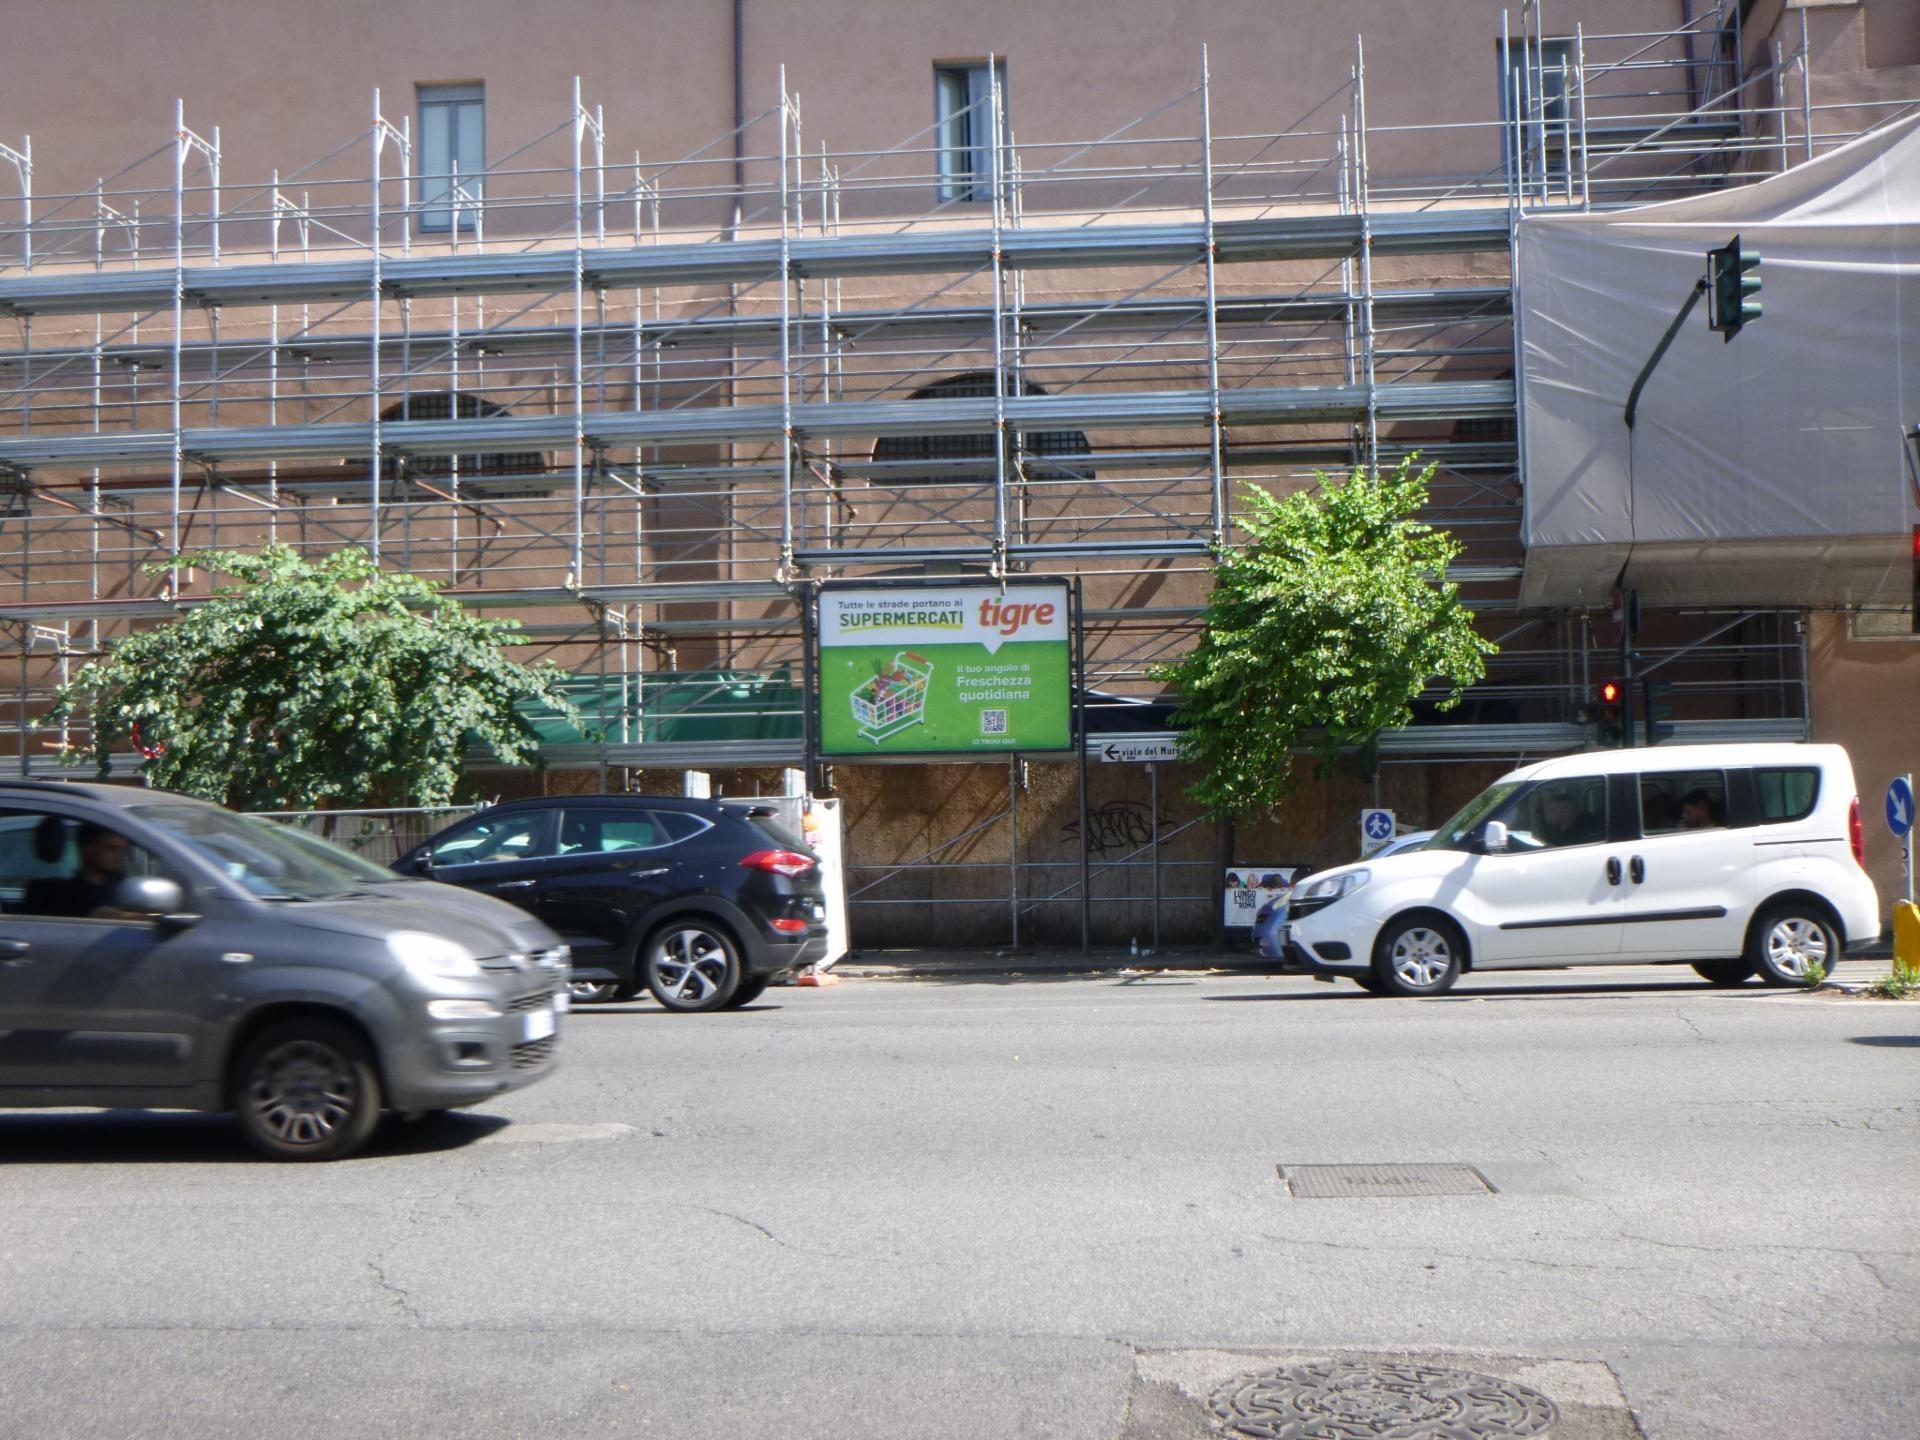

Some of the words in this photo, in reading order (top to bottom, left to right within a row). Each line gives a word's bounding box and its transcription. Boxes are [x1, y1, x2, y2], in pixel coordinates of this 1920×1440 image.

[838, 601, 864, 609] Tutte
[866, 600, 876, 609] le
[878, 600, 909, 609] strade
[912, 599, 951, 609] portano
[953, 598, 963, 607] ai
[840, 611, 963, 627] SUPERMERCATI
[979, 597, 1055, 635] tigre
[965, 664, 982, 673] tuo
[984, 663, 1019, 674] angolo
[1021, 663, 1031, 672] di
[957, 675, 1032, 687] Freschezza
[959, 689, 1030, 703] quotidiana
[1122, 748, 1141, 756] viale
[1144, 747, 1157, 755] del
[1234, 890, 1256, 898] LUNGO
